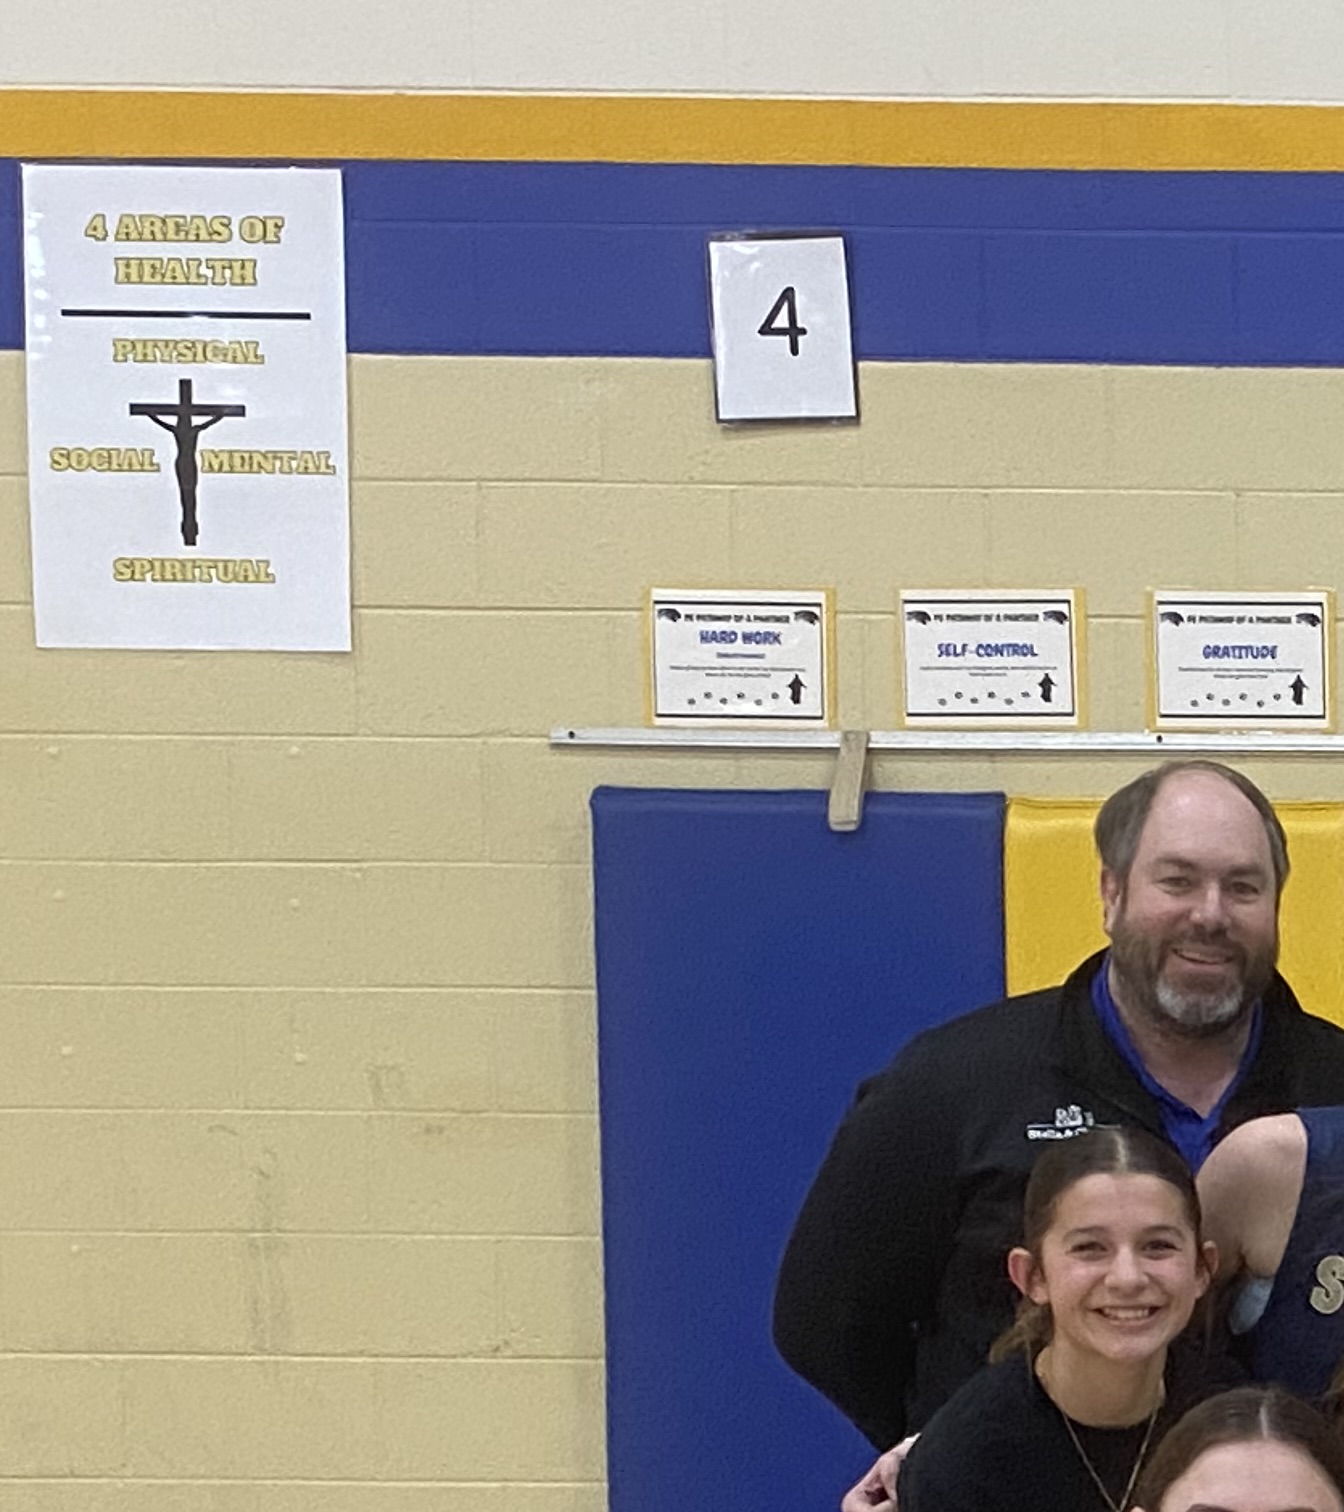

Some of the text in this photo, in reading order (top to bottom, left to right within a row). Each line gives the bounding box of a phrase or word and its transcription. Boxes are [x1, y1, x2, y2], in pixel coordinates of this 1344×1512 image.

[85, 215, 285, 244] 4 AREAS OF
[115, 258, 257, 286] HEALTH
[757, 286, 808, 357] 4
[112, 339, 265, 364] PHYSICAL
[49, 447, 160, 472] SOCIAL
[201, 449, 336, 475] MENTAL
[113, 557, 276, 583] SPIRITUAL
[700, 630, 783, 645] HARD WORK
[937, 643, 1038, 658] SELF-CONTROL
[1202, 644, 1279, 660] GRATITUDE
